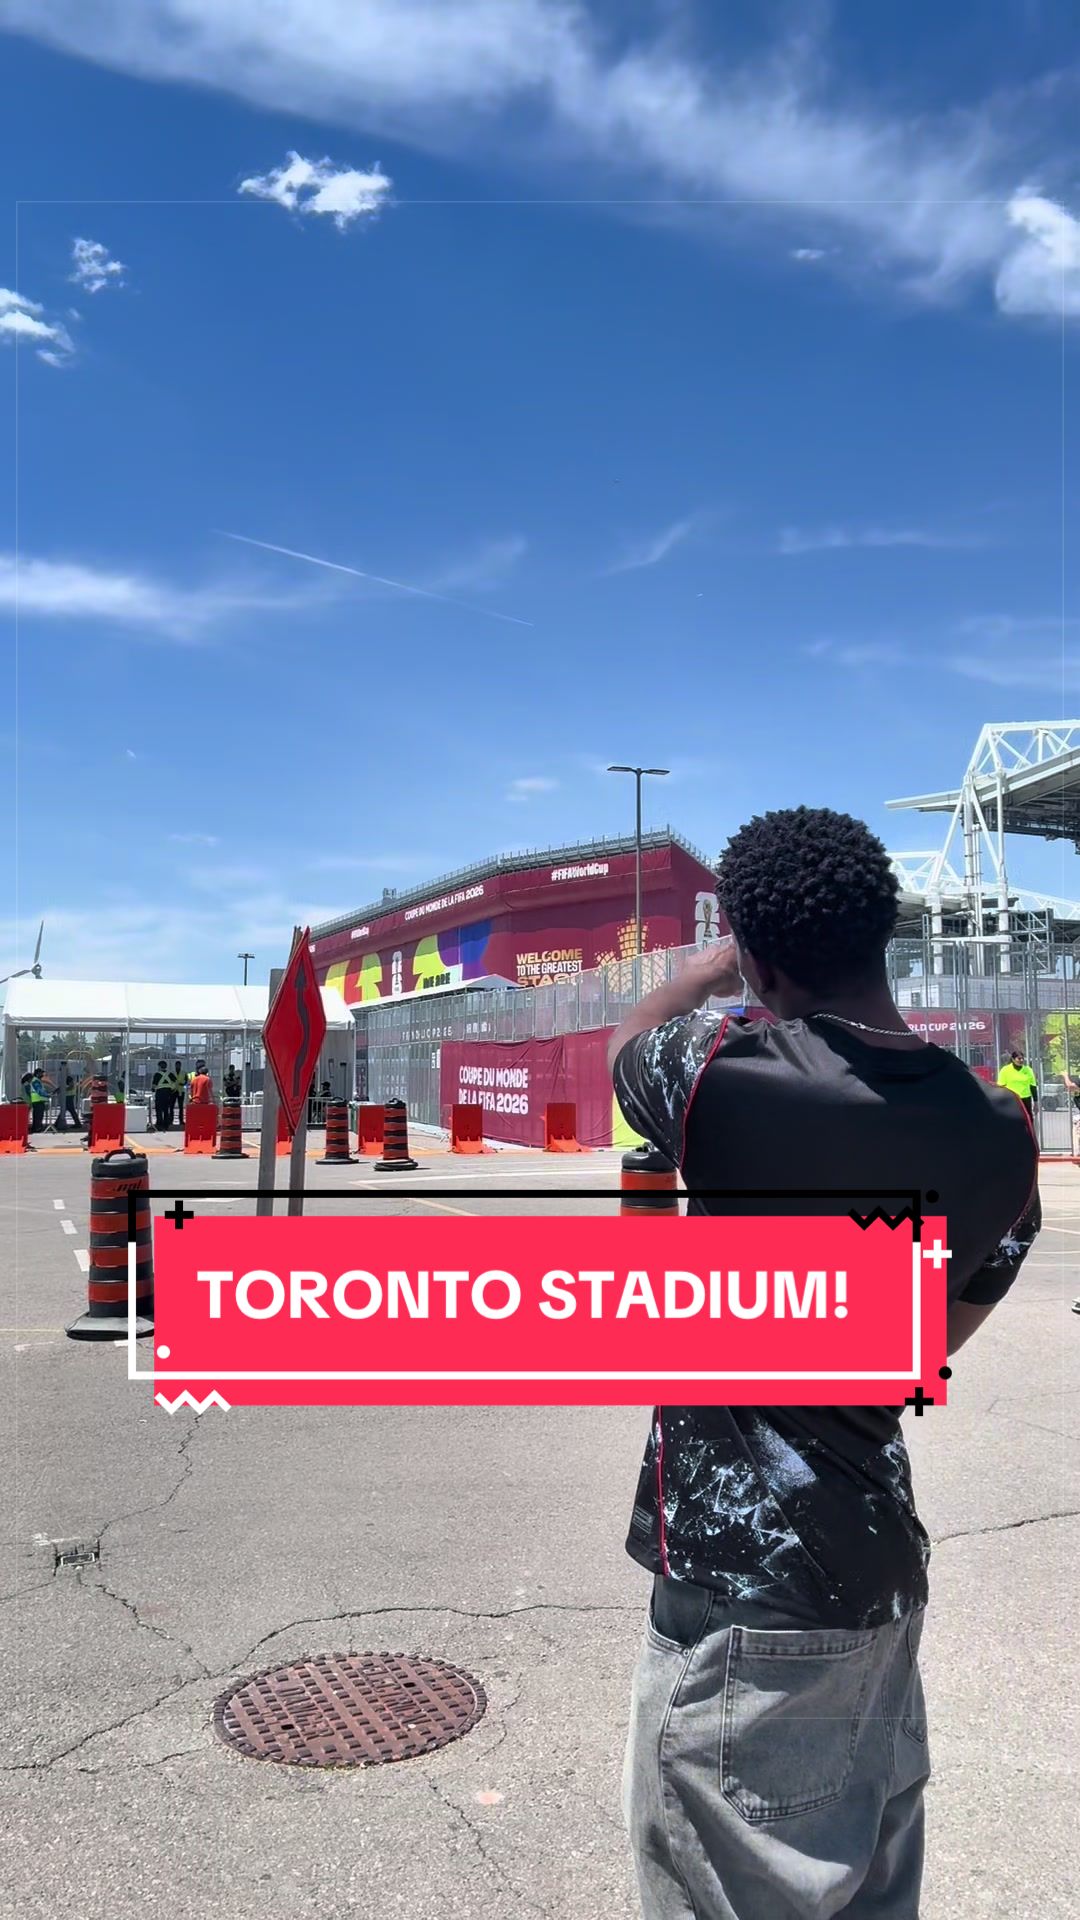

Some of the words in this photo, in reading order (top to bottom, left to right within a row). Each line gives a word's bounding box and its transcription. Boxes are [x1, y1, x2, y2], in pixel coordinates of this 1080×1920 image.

[551, 863, 609, 881] #FIFAWorldCup
[404, 907, 419, 920] COUPE
[419, 905, 425, 916] DU
[425, 900, 441, 914] MONDE
[441, 897, 448, 908] DE
[448, 895, 454, 905] LA
[454, 891, 465, 904] FIFA
[465, 885, 484, 900] 2026
[516, 948, 583, 965] WELCOME
[516, 965, 526, 977] TO
[526, 962, 541, 975] THE
[541, 960, 583, 974] GREATEST
[928, 1023, 948, 1032] CUP
[459, 1065, 483, 1086] COUPE
[483, 1067, 495, 1087] DU
[496, 1067, 529, 1089] MONDE
[458, 1087, 468, 1105] DE
[468, 1089, 477, 1105] LA
[478, 1090, 496, 1111] FIFA
[496, 1092, 529, 1115] 2026
[275, 1686, 335, 1741] DANGER
